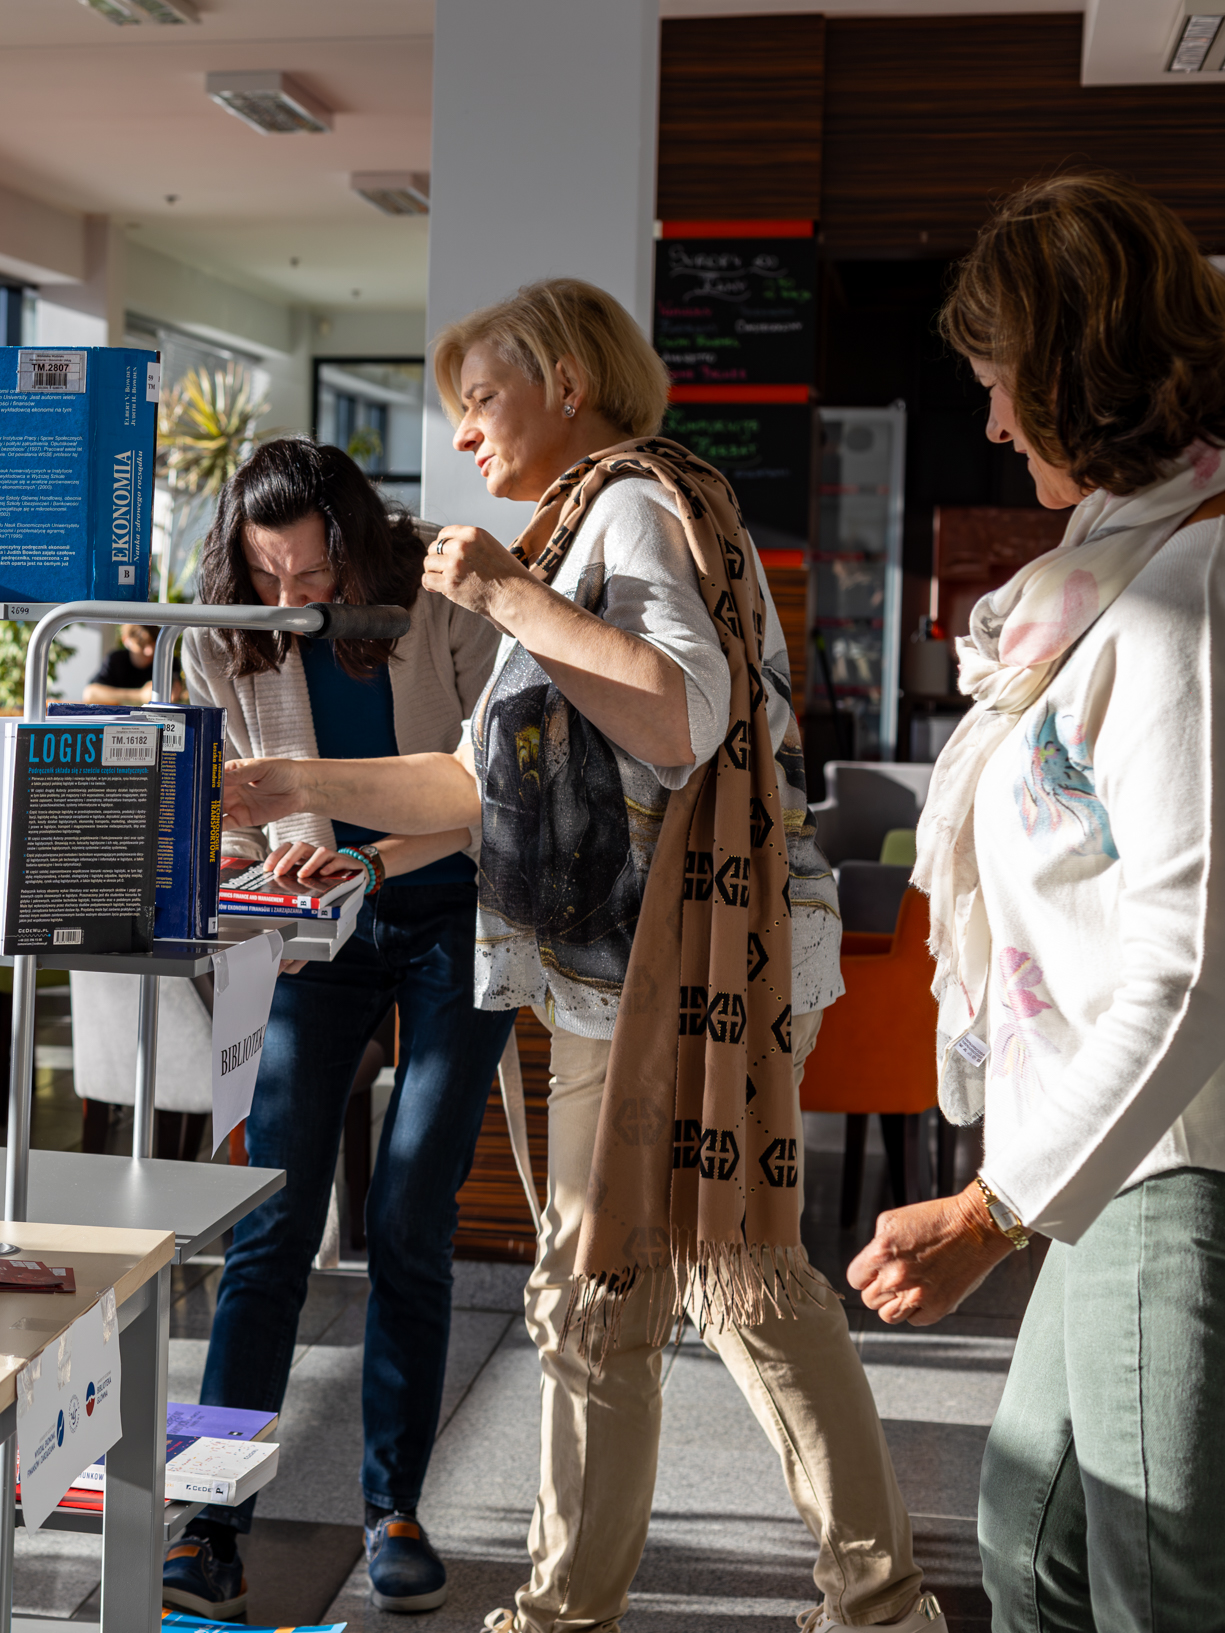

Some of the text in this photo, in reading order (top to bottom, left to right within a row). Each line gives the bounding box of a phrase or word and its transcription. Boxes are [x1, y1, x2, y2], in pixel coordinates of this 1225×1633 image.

[32, 364, 69, 372] TM.2807
[135, 450, 144, 490] rozsądku
[112, 450, 132, 562] EKONOMIA
[134, 491, 143, 532] zdrowego
[124, 570, 130, 578] B
[28, 733, 104, 763] LOGIST
[112, 736, 148, 745] TM.16182
[221, 1024, 266, 1076] BIBLIOTEK
[96, 1376, 112, 1394] BIBLIOTEKA
[96, 1391, 108, 1404] GŁÓWNA
